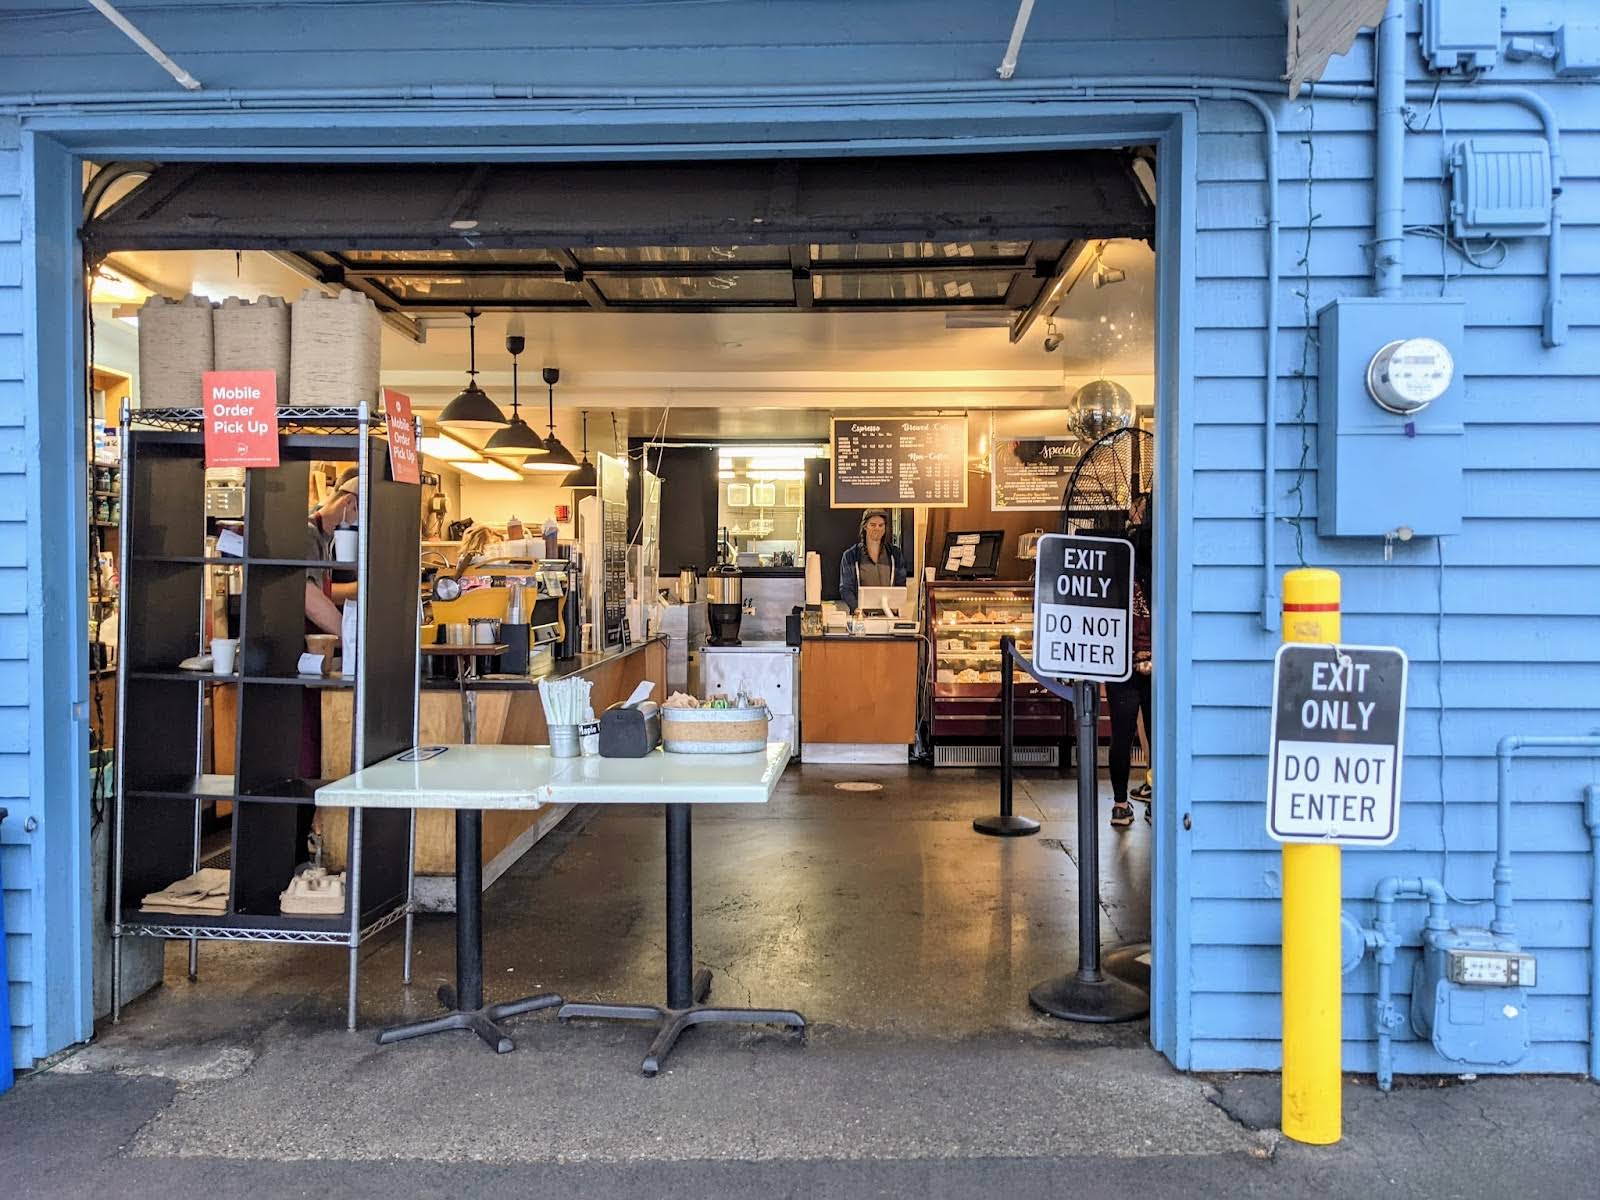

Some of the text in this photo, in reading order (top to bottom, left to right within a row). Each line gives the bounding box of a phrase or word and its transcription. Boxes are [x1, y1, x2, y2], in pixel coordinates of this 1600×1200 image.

[212, 386, 261, 400] Mobile
[212, 404, 255, 417] Order
[213, 421, 269, 437] Pick Up
[391, 415, 410, 432] Mobile
[851, 423, 880, 433] Espresso
[394, 431, 410, 446] Order
[393, 446, 415, 464] Pick Up
[1064, 548, 1107, 572] EXIT
[1057, 574, 1111, 598] ONLY
[1045, 613, 1121, 638] DO NOT
[1050, 641, 1114, 665] ENTER
[1312, 661, 1370, 693] EXIT
[1301, 699, 1376, 731] ONLY
[1285, 755, 1386, 785] DO NOT
[1290, 793, 1376, 822] ENTER
